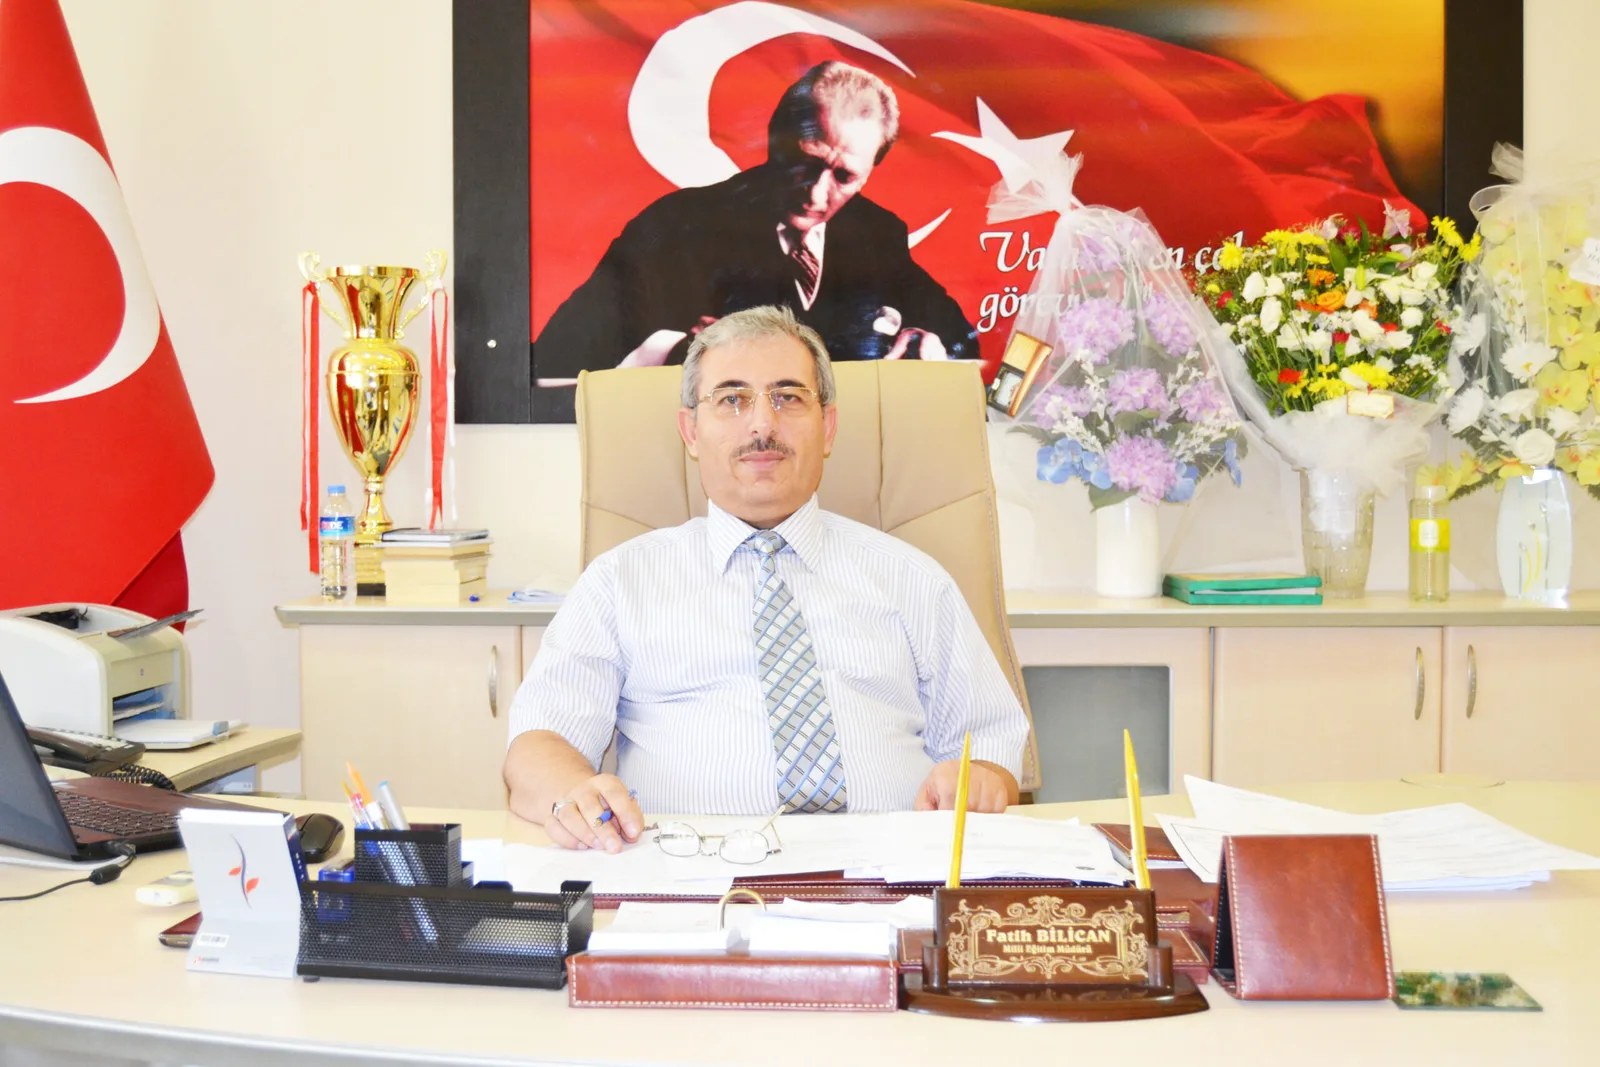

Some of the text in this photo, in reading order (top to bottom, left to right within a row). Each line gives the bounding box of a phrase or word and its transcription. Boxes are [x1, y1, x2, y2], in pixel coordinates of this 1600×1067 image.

[986, 926, 1111, 943] Fatih BİLİCAN
[1002, 944, 1024, 954] Milli
